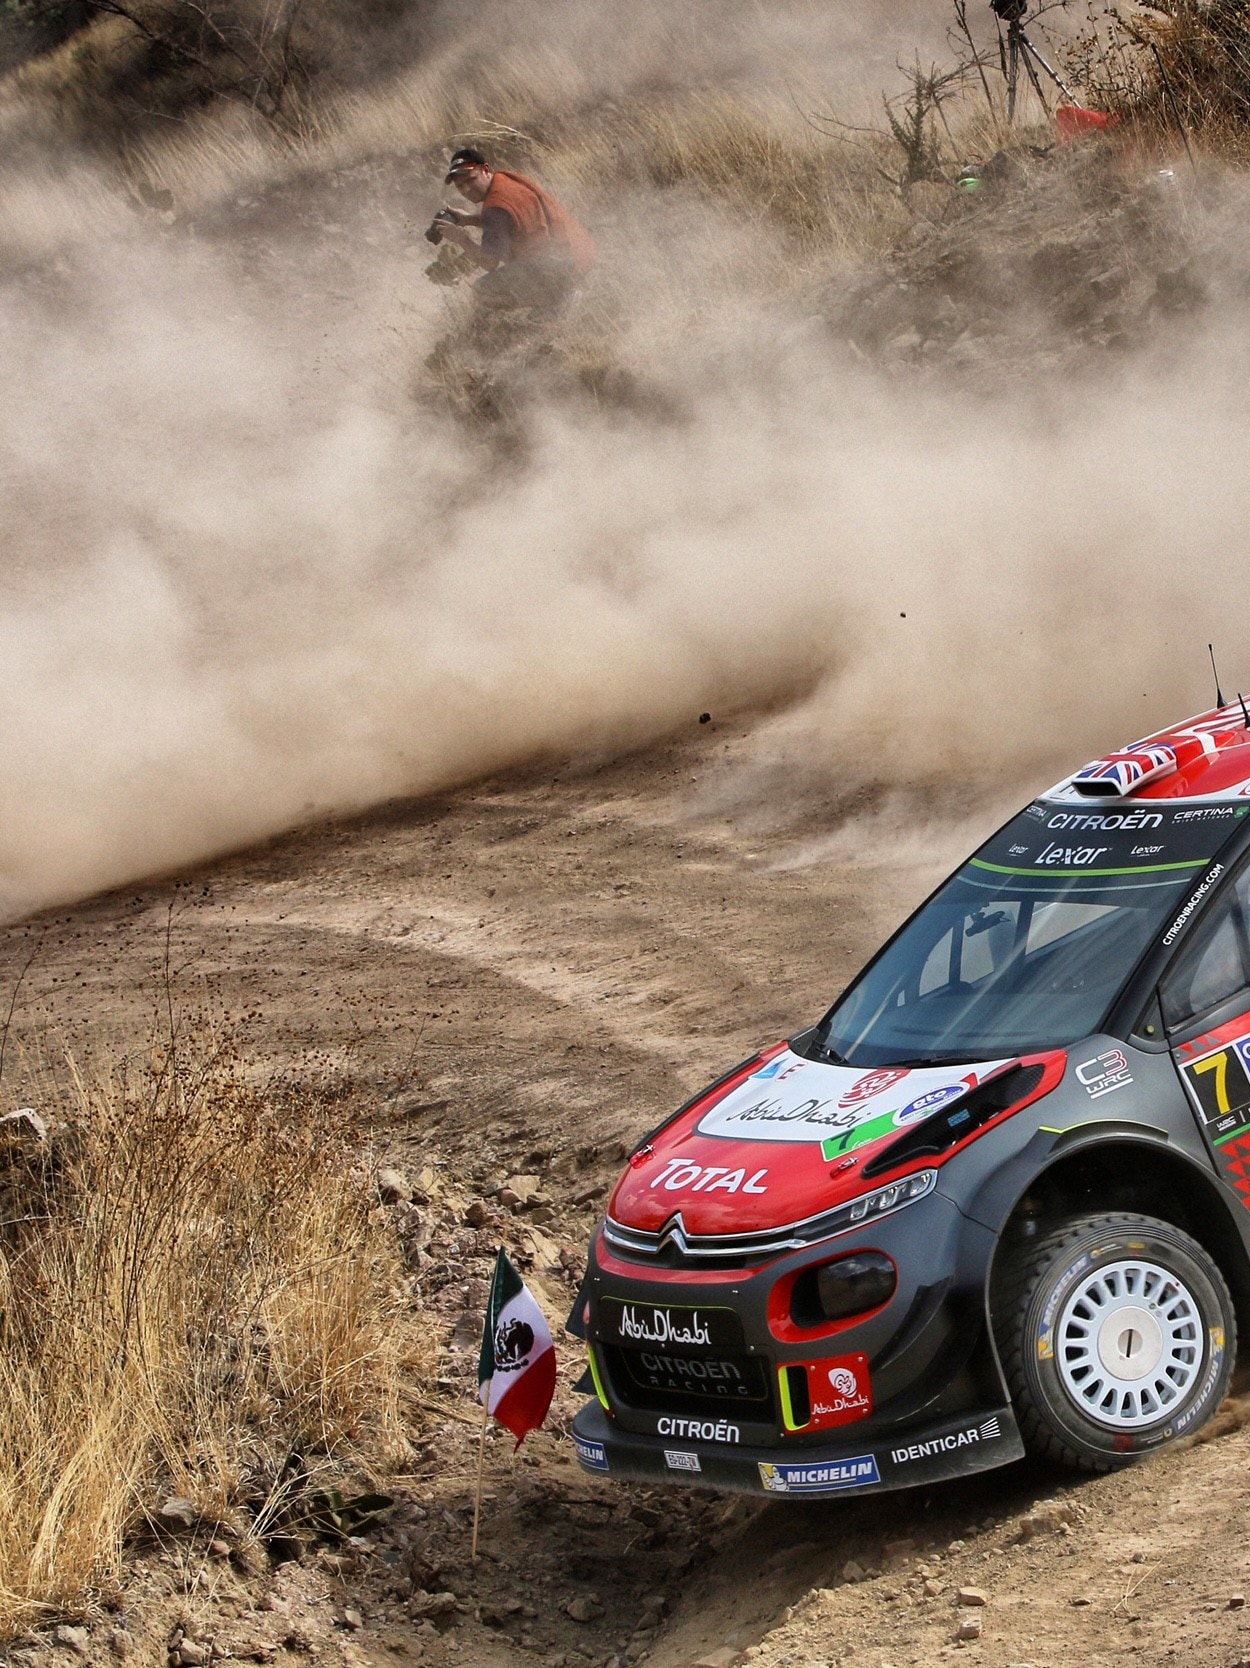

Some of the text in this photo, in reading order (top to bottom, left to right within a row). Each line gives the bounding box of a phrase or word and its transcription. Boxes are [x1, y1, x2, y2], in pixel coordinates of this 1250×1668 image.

[1174, 807, 1233, 820] CERTINA
[1035, 841, 1109, 865] Lexar
[1130, 845, 1165, 855] Lexar
[1162, 863, 1225, 946] CITROENRACING.COM
[1075, 1048, 1128, 1086] C3
[1085, 1068, 1132, 1094] WRC
[1193, 1051, 1231, 1114] 7
[912, 1089, 948, 1110] gto
[830, 1129, 856, 1151] 7
[650, 1158, 769, 1194] TOTAL
[650, 1376, 748, 1395] RACING
[891, 1427, 980, 1463] IDENTICAR
[787, 1462, 873, 1482] MICHELIN
